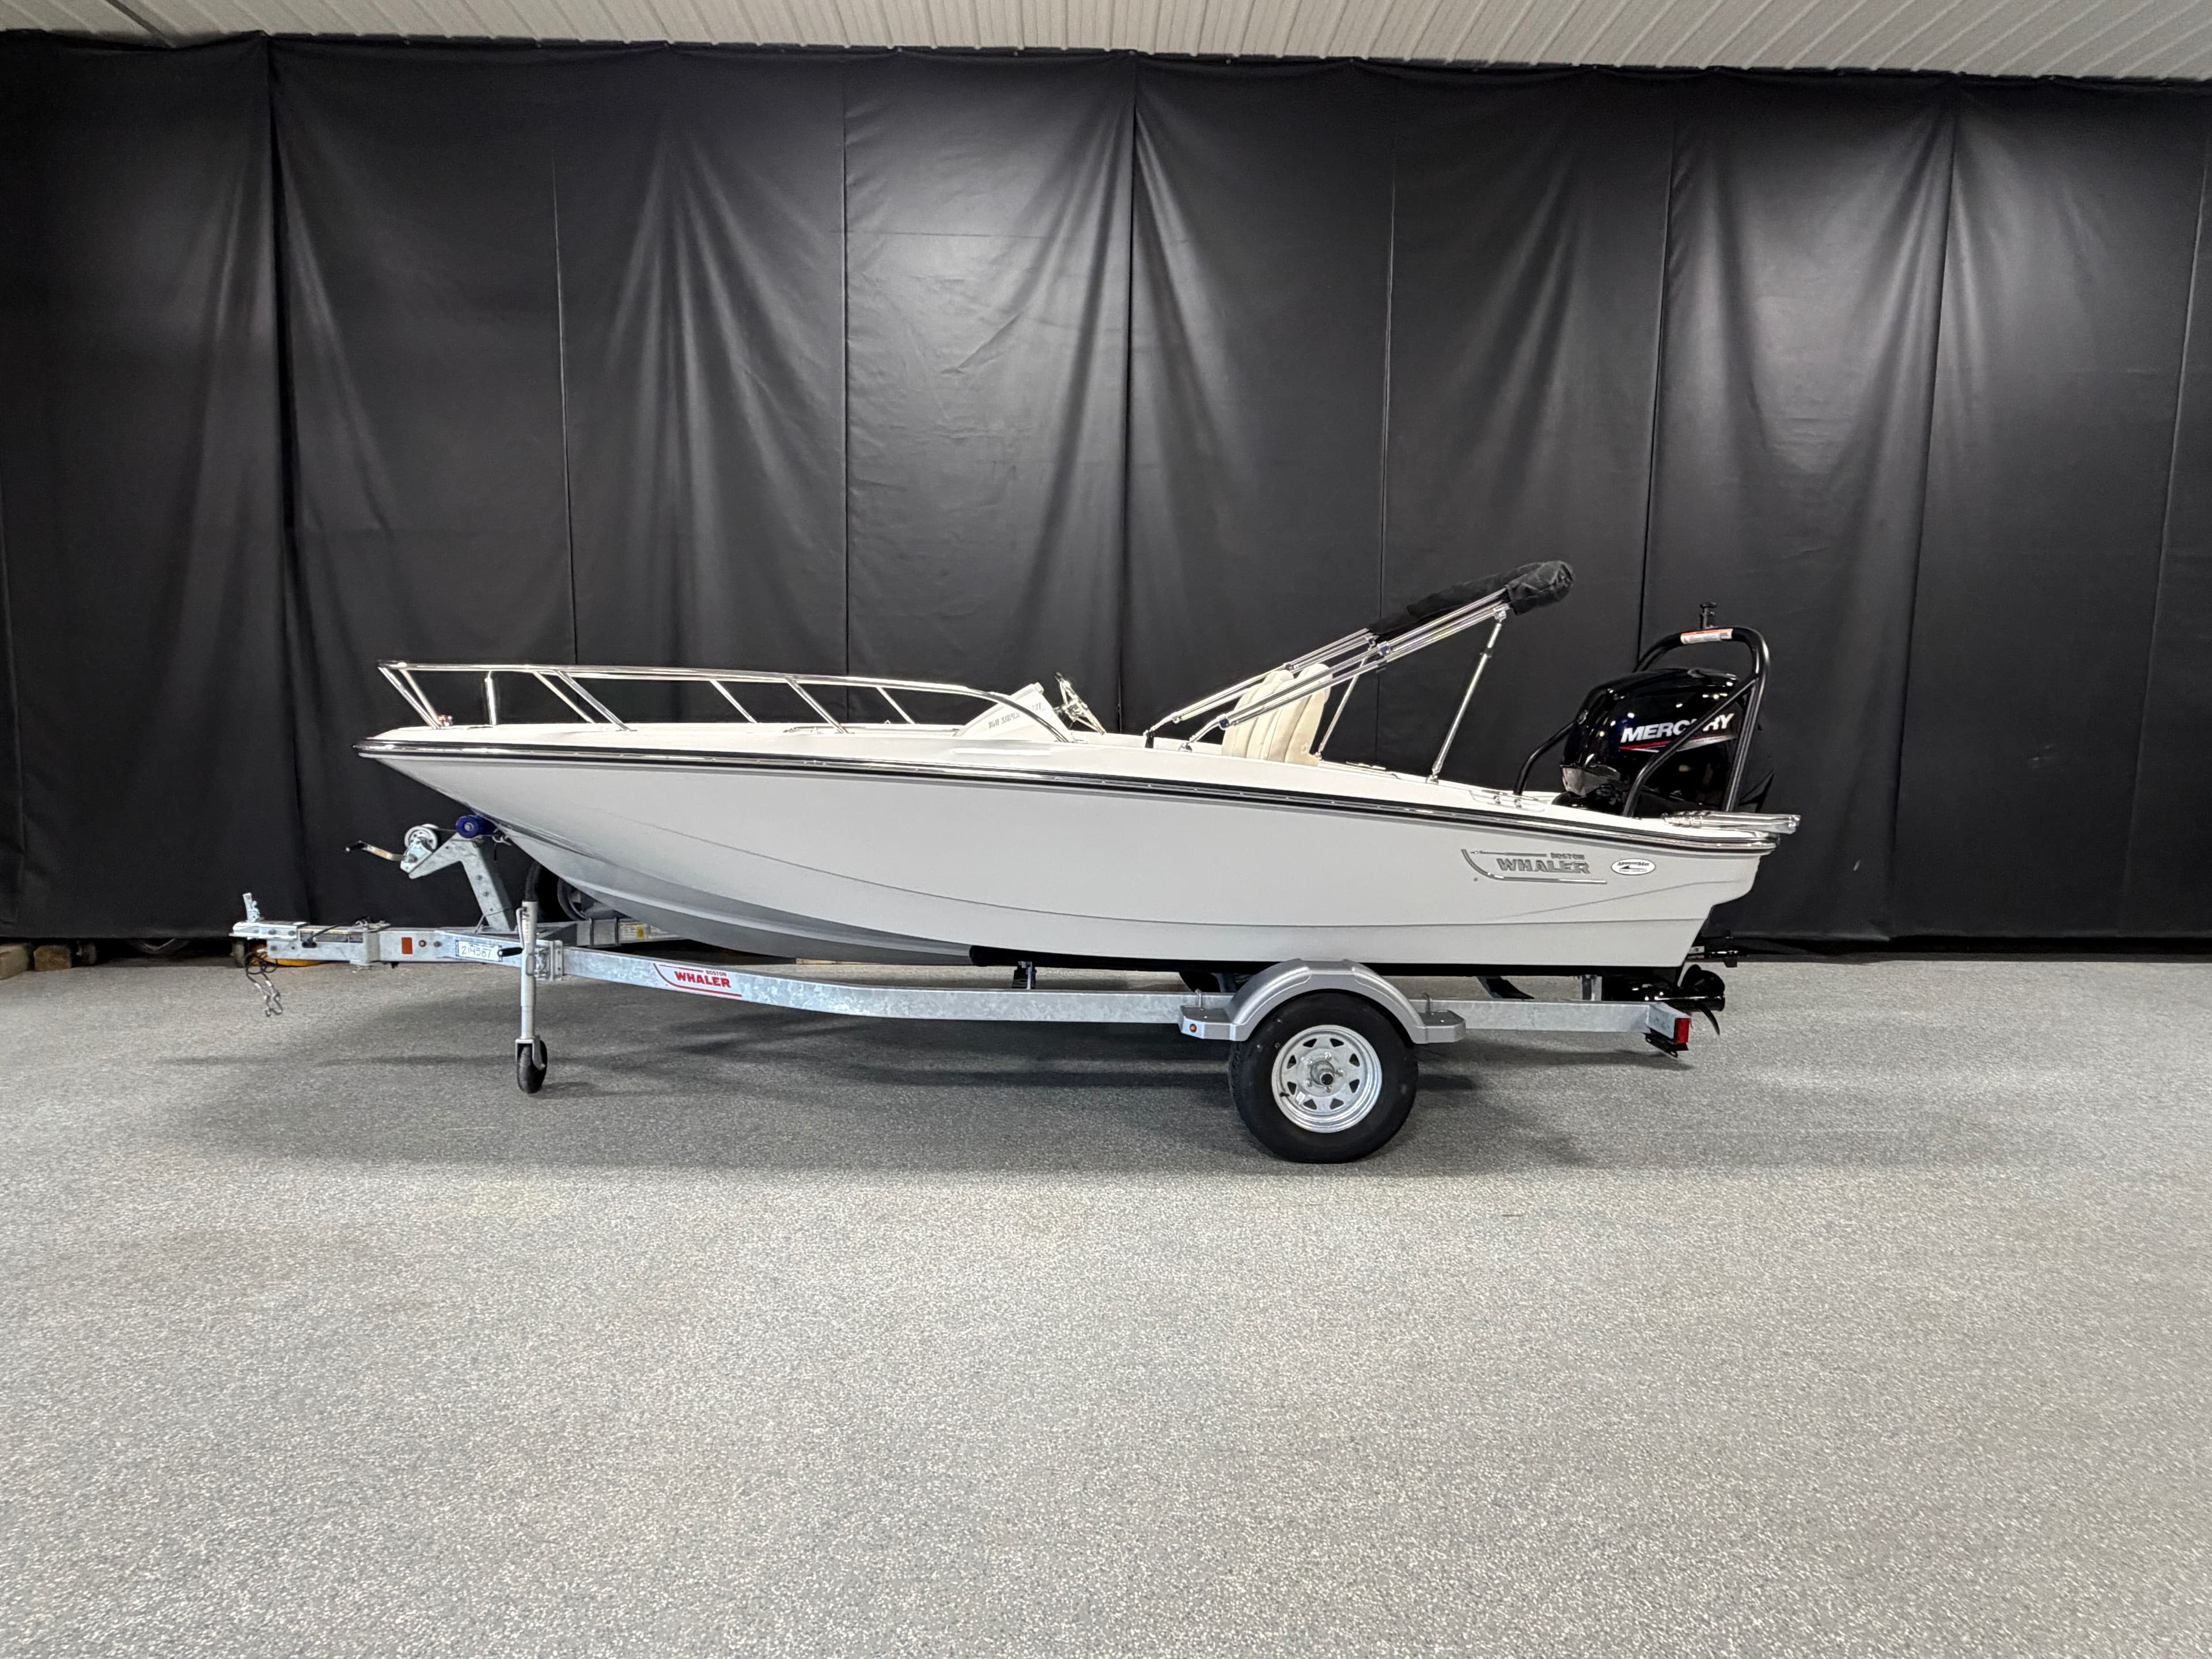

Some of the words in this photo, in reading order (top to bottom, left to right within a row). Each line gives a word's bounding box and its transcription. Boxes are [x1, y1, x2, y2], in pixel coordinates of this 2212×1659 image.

[1620, 713, 1734, 743] MERCRY
[1497, 858, 1590, 874] WHALER
[674, 971, 731, 988] WHALER
